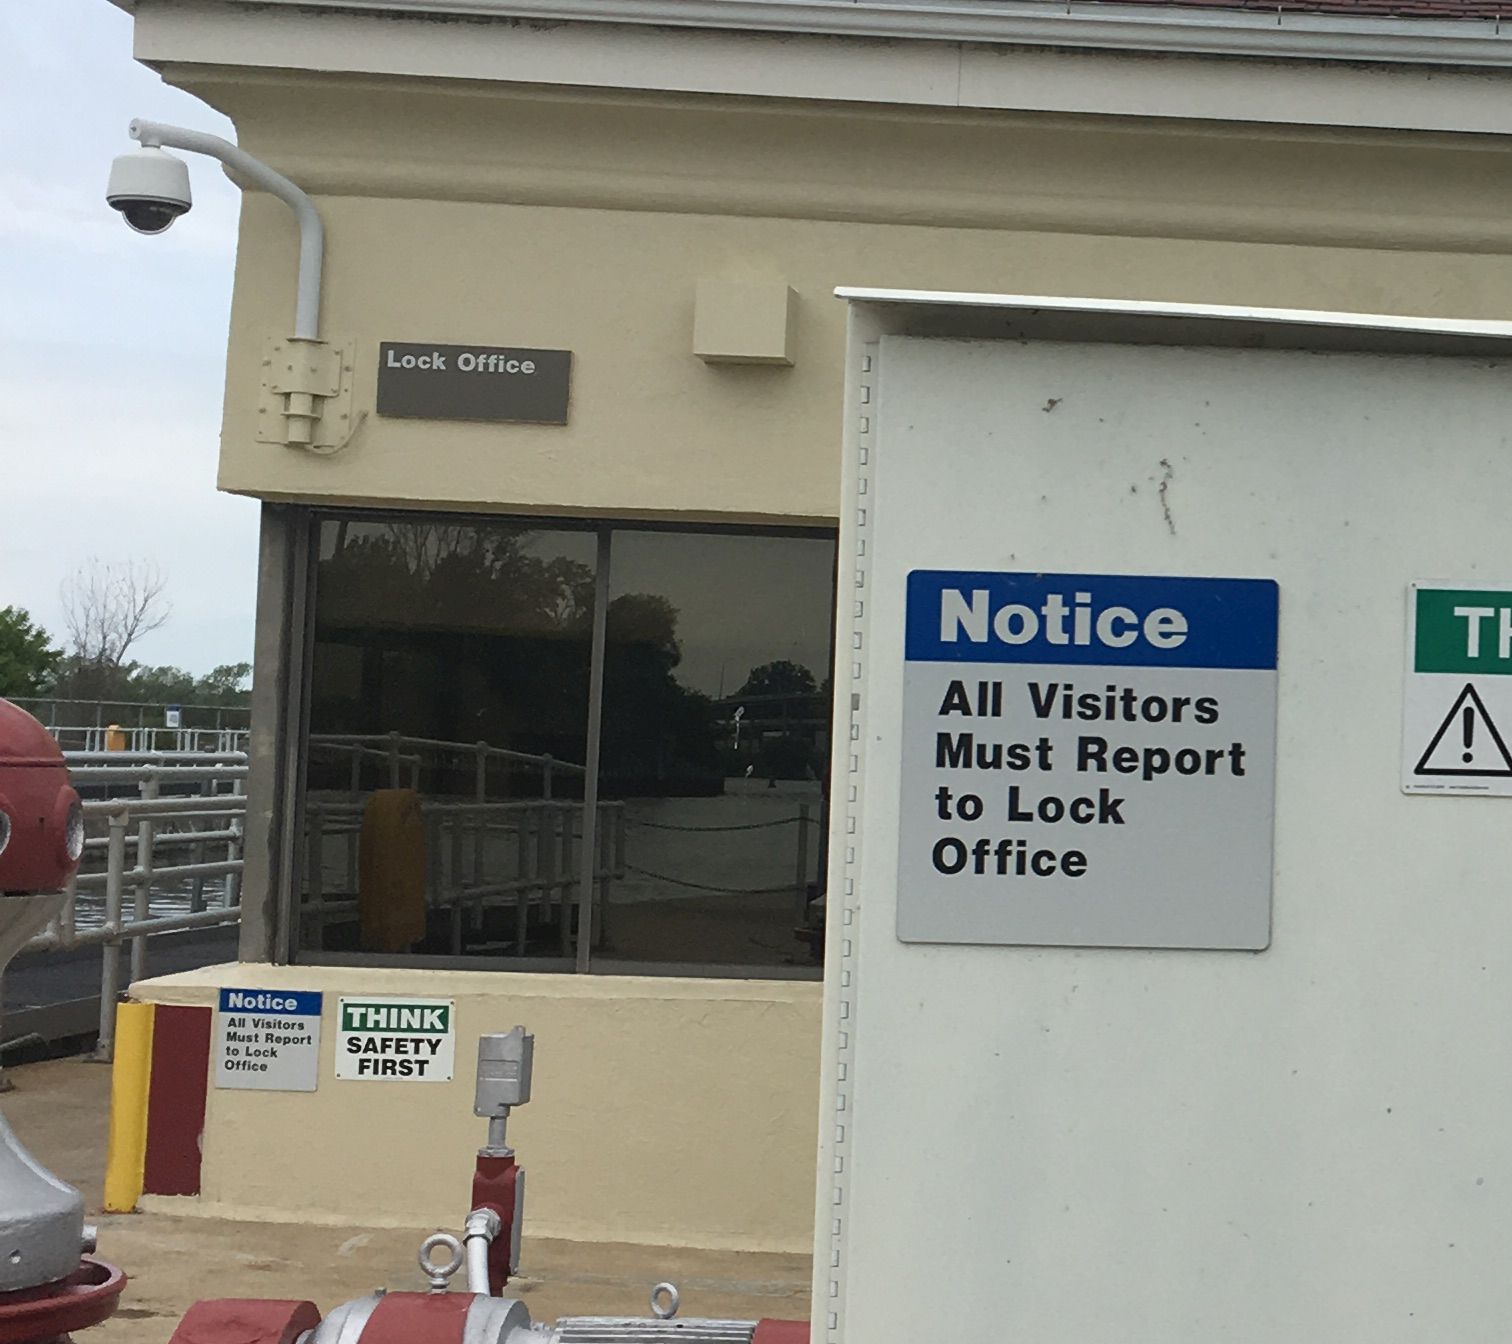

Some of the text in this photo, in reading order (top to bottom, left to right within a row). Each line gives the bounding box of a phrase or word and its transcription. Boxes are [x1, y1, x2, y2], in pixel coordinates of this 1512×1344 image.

[387, 349, 536, 374] Lock Office
[940, 588, 1189, 649] Notice
[938, 680, 1220, 724] All Visitors
[935, 732, 1246, 781] Must Report
[935, 786, 1126, 825] to Lock
[932, 837, 1088, 877] Office
[228, 992, 298, 1011] Notice
[227, 1017, 305, 1031] All Visitors
[346, 1007, 445, 1030] THINK
[226, 1031, 312, 1046] Must Report
[346, 1036, 442, 1056] SAFETY
[226, 1046, 278, 1058] to Lock
[224, 1059, 268, 1072] Office
[357, 1058, 430, 1077] FIRST
